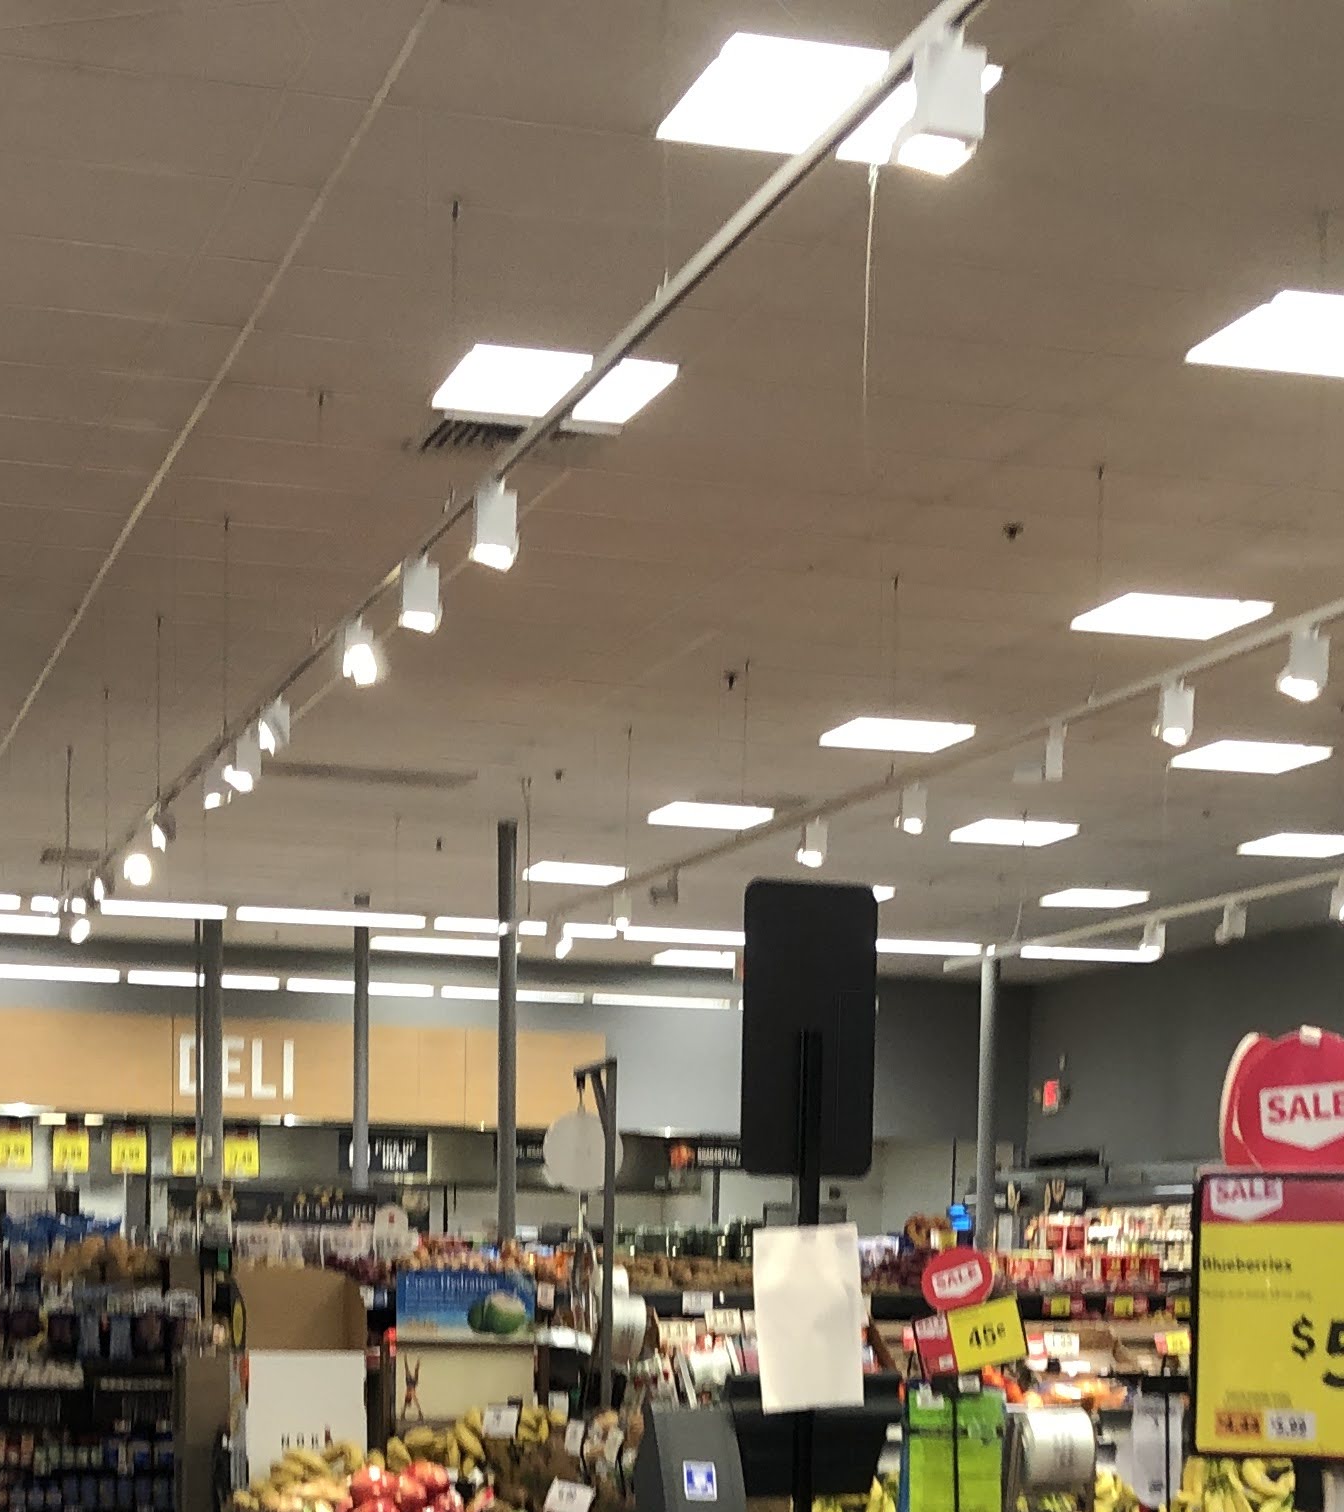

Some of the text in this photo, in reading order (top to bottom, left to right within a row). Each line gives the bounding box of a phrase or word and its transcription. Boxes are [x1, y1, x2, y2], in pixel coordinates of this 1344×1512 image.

[179, 1034, 295, 1101] DELI
[1216, 1177, 1279, 1204] SALE
[936, 1264, 978, 1289] SALE
